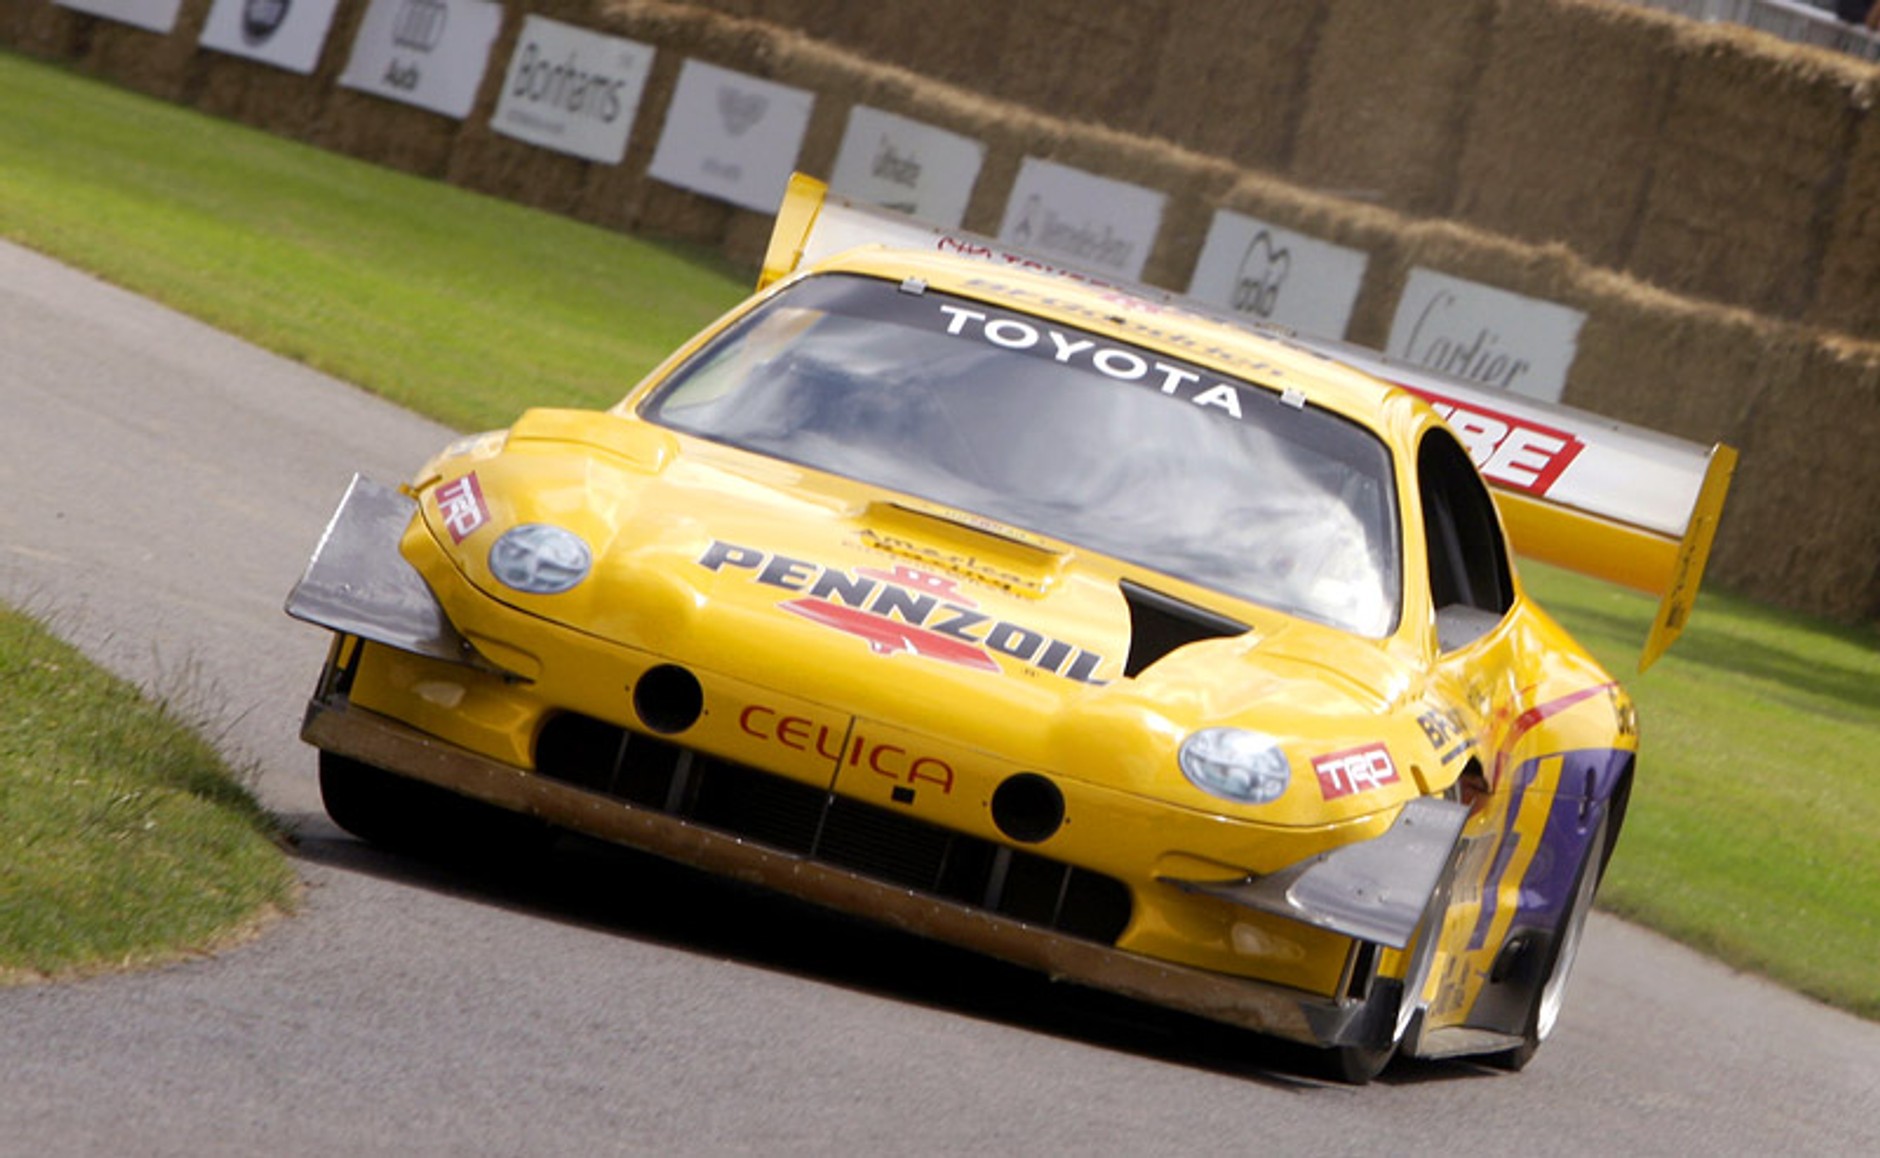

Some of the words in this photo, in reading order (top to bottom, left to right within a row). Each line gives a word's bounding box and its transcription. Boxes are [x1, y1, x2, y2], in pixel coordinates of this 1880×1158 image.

[940, 304, 1242, 418] TOYOTA
[1403, 288, 1530, 388] Cartier
[438, 476, 483, 536] TRD
[697, 538, 1110, 688] PENNZOIL
[739, 703, 955, 785] CELICA
[1315, 749, 1395, 796] TRD
